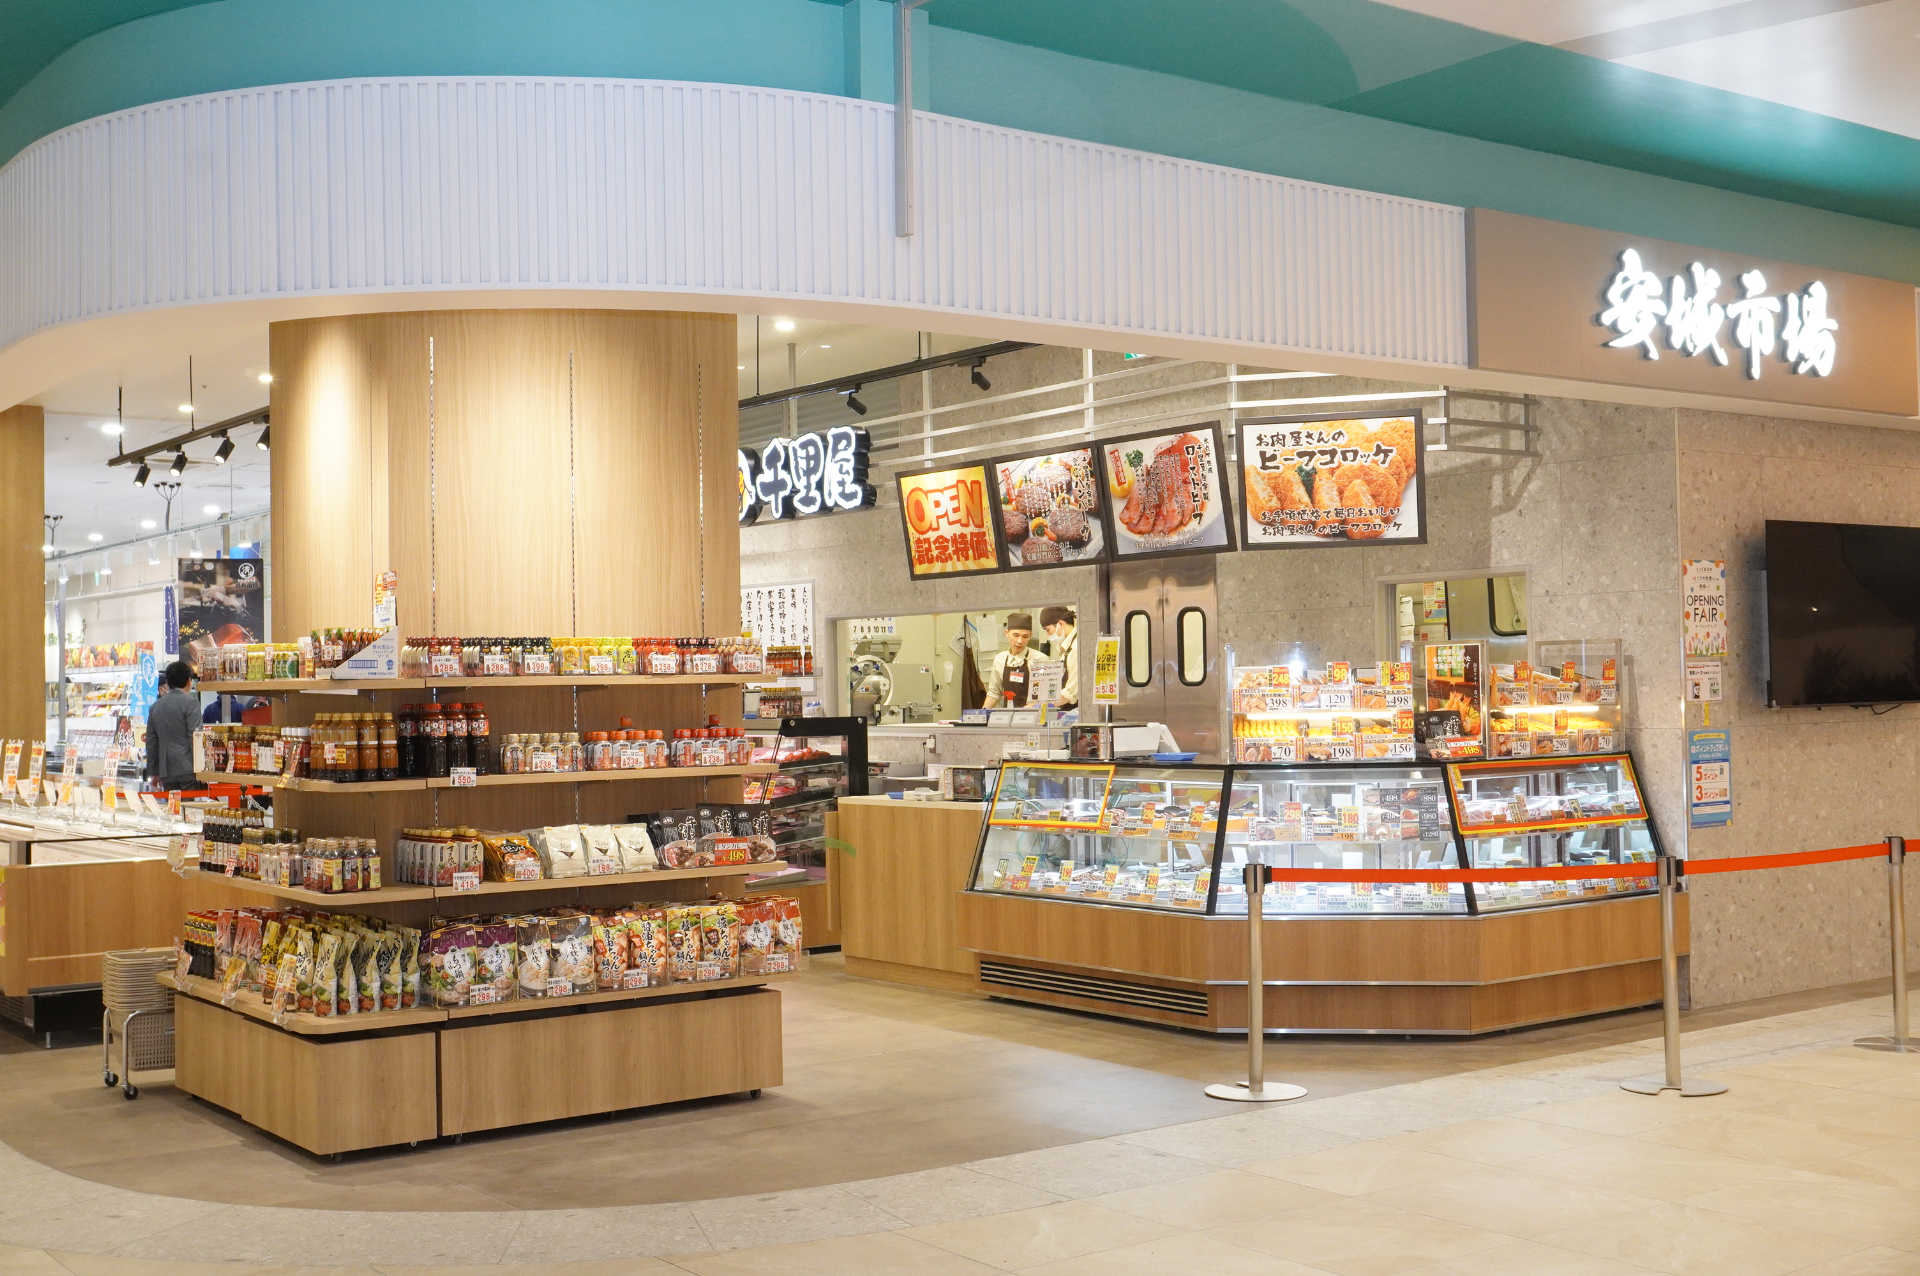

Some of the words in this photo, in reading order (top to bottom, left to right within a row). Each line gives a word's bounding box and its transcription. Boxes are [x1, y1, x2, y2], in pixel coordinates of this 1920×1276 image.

[1601, 248, 1838, 380] 安城市場
[1256, 430, 1345, 447] お肉屋さんの
[1259, 443, 1394, 471] ビーフコロッケ
[1184, 443, 1203, 525] ローストビーフ
[906, 479, 985, 535] OPEN
[1261, 507, 1401, 522] お手頃価格で毎日おいしい
[1262, 521, 1403, 537] お肉屋さんのビーフコロッケ
[914, 531, 990, 566] 記念特価
[1686, 594, 1725, 607] OPENING
[1693, 607, 1718, 623] FAIR
[853, 625, 857, 633] 7
[860, 625, 864, 633] 8
[867, 625, 871, 633] 9
[873, 625, 880, 633] 10
[880, 625, 886, 633] 11
[887, 625, 893, 633] 12
[1096, 653, 1117, 663] レジ袋は
[1273, 673, 1289, 684] 248
[1333, 668, 1348, 682] 98
[1394, 672, 1410, 682] 380
[1336, 722, 1353, 734] 150
[1396, 717, 1414, 729] 120
[1284, 809, 1301, 820] 298
[1342, 813, 1359, 824] 180
